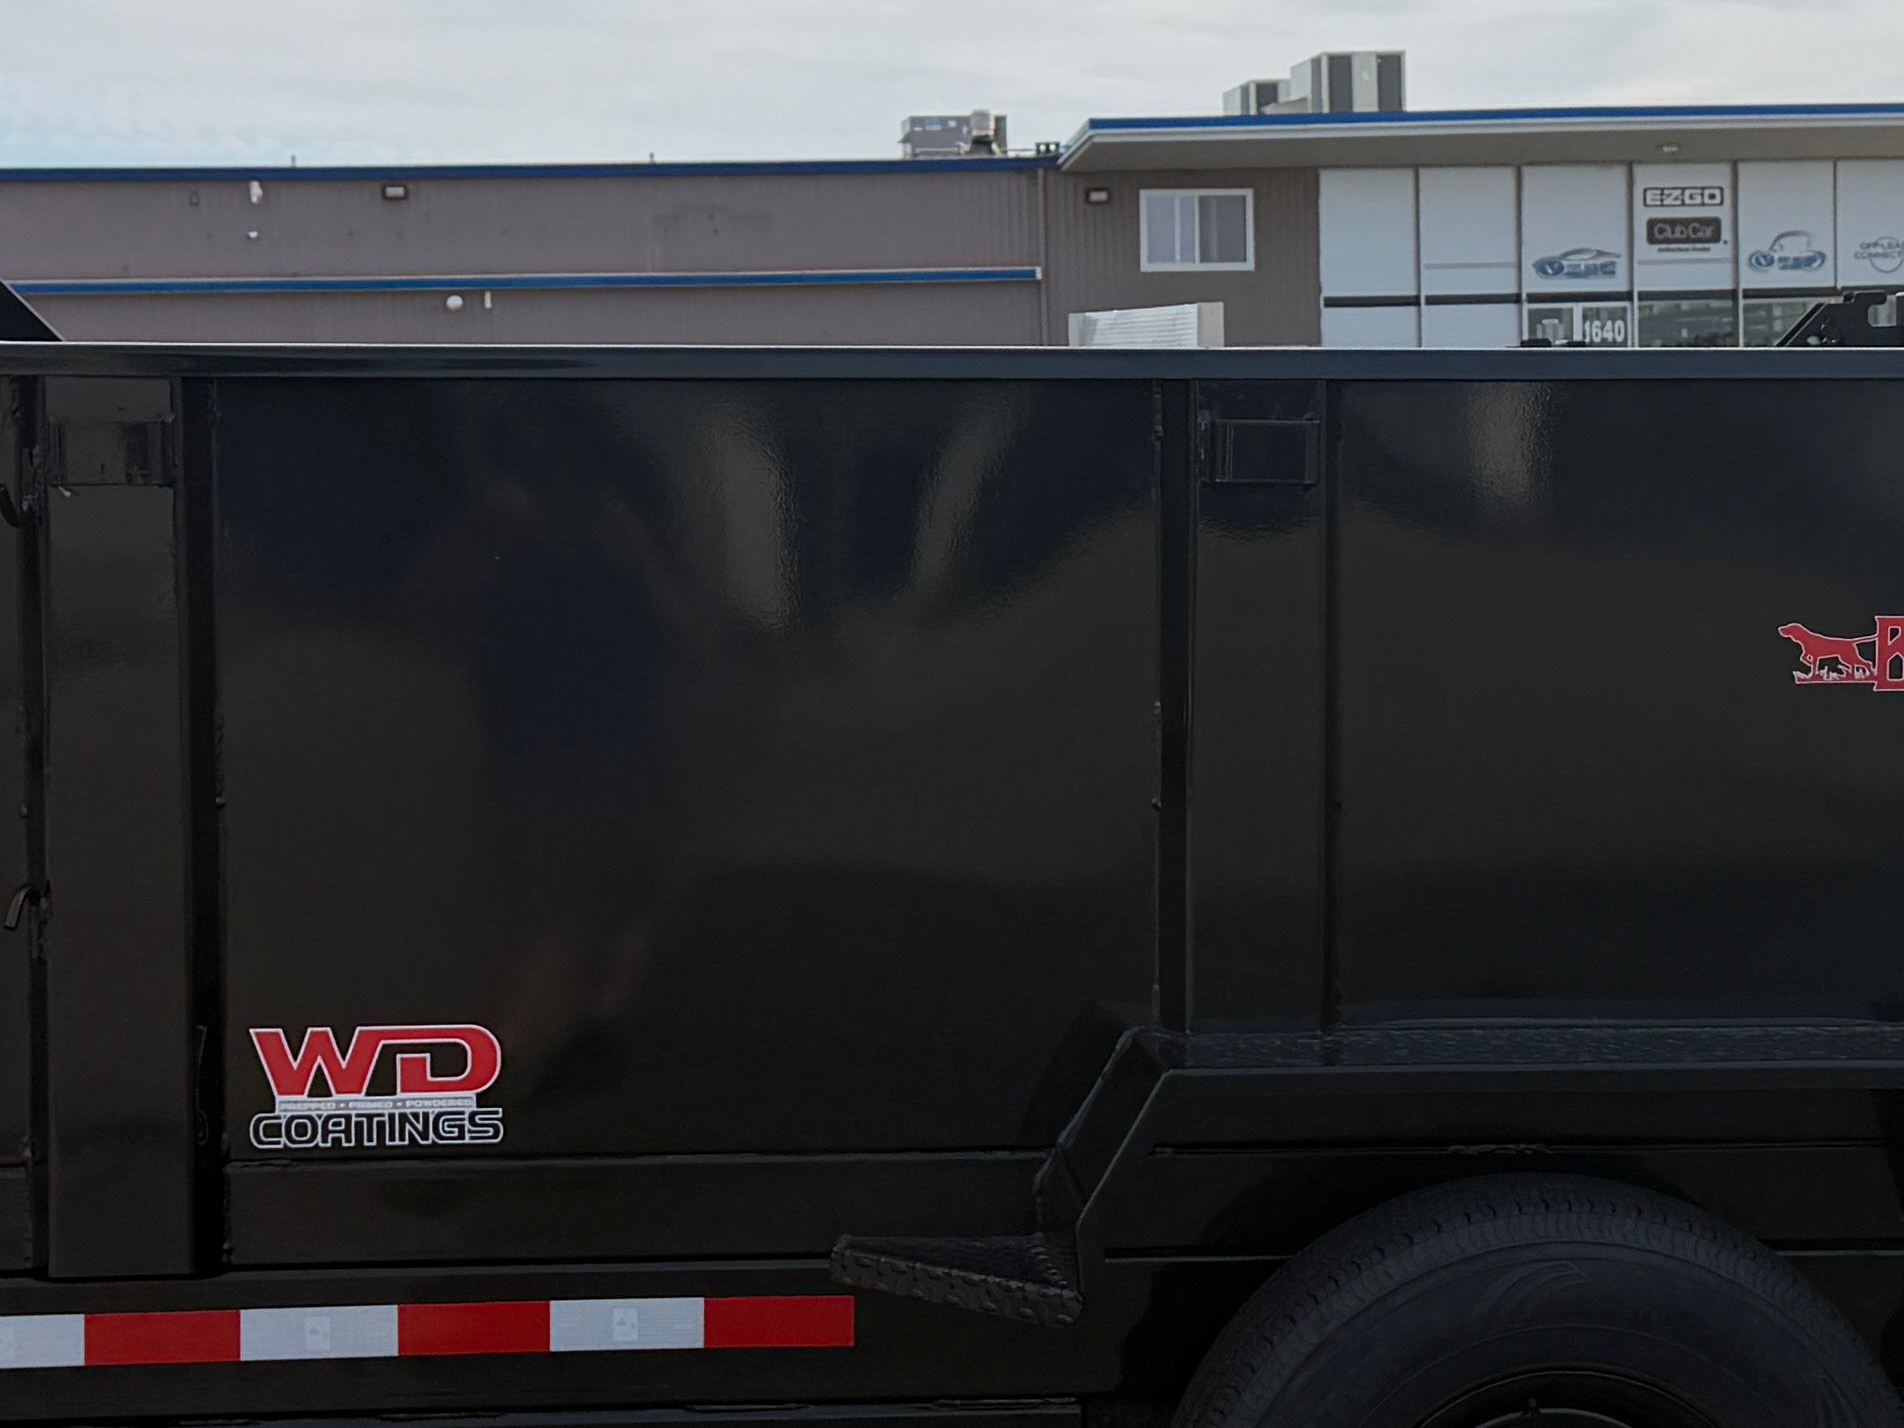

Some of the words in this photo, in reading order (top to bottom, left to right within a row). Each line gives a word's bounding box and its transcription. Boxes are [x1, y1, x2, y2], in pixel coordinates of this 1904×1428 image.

[1653, 222, 1687, 239] Club
[1688, 222, 1714, 239] Car
[1584, 319, 1625, 343] 1640
[249, 1024, 502, 1098] WD
[249, 1107, 504, 1150] COATINGS
